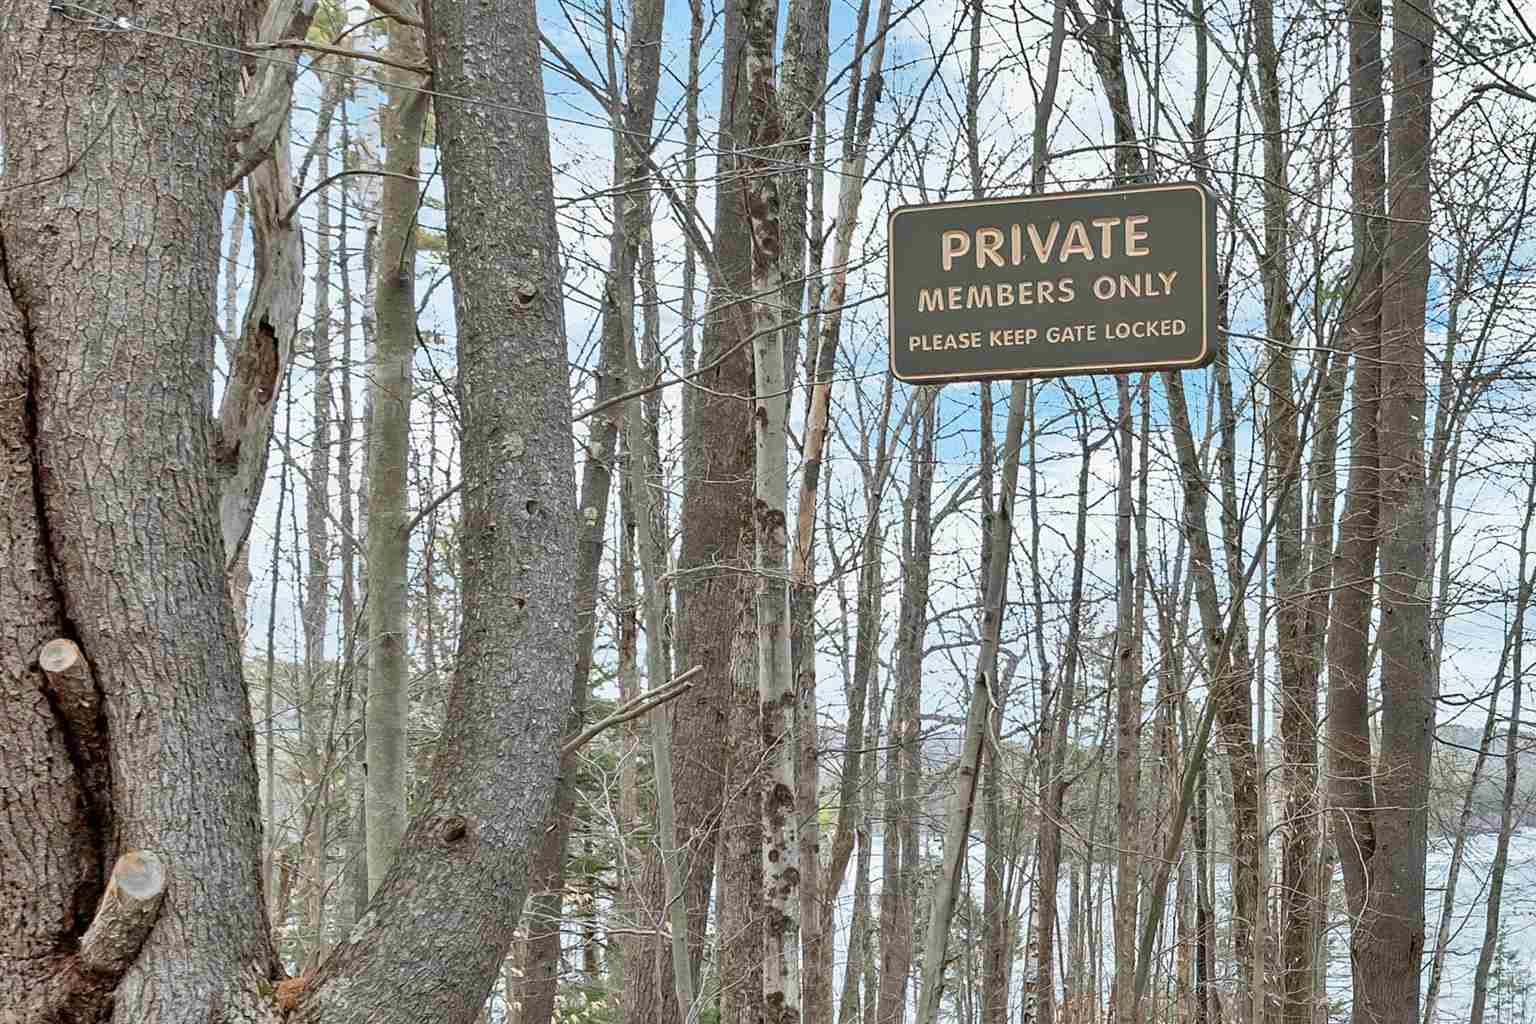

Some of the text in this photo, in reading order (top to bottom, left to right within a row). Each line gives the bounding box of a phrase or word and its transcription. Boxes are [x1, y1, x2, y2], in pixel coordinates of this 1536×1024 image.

[941, 214, 1152, 272] PRIVATE
[917, 270, 1178, 313] MEMBERS ONLY
[908, 319, 1186, 352] PLEASE KEEP GATE LOCKED
